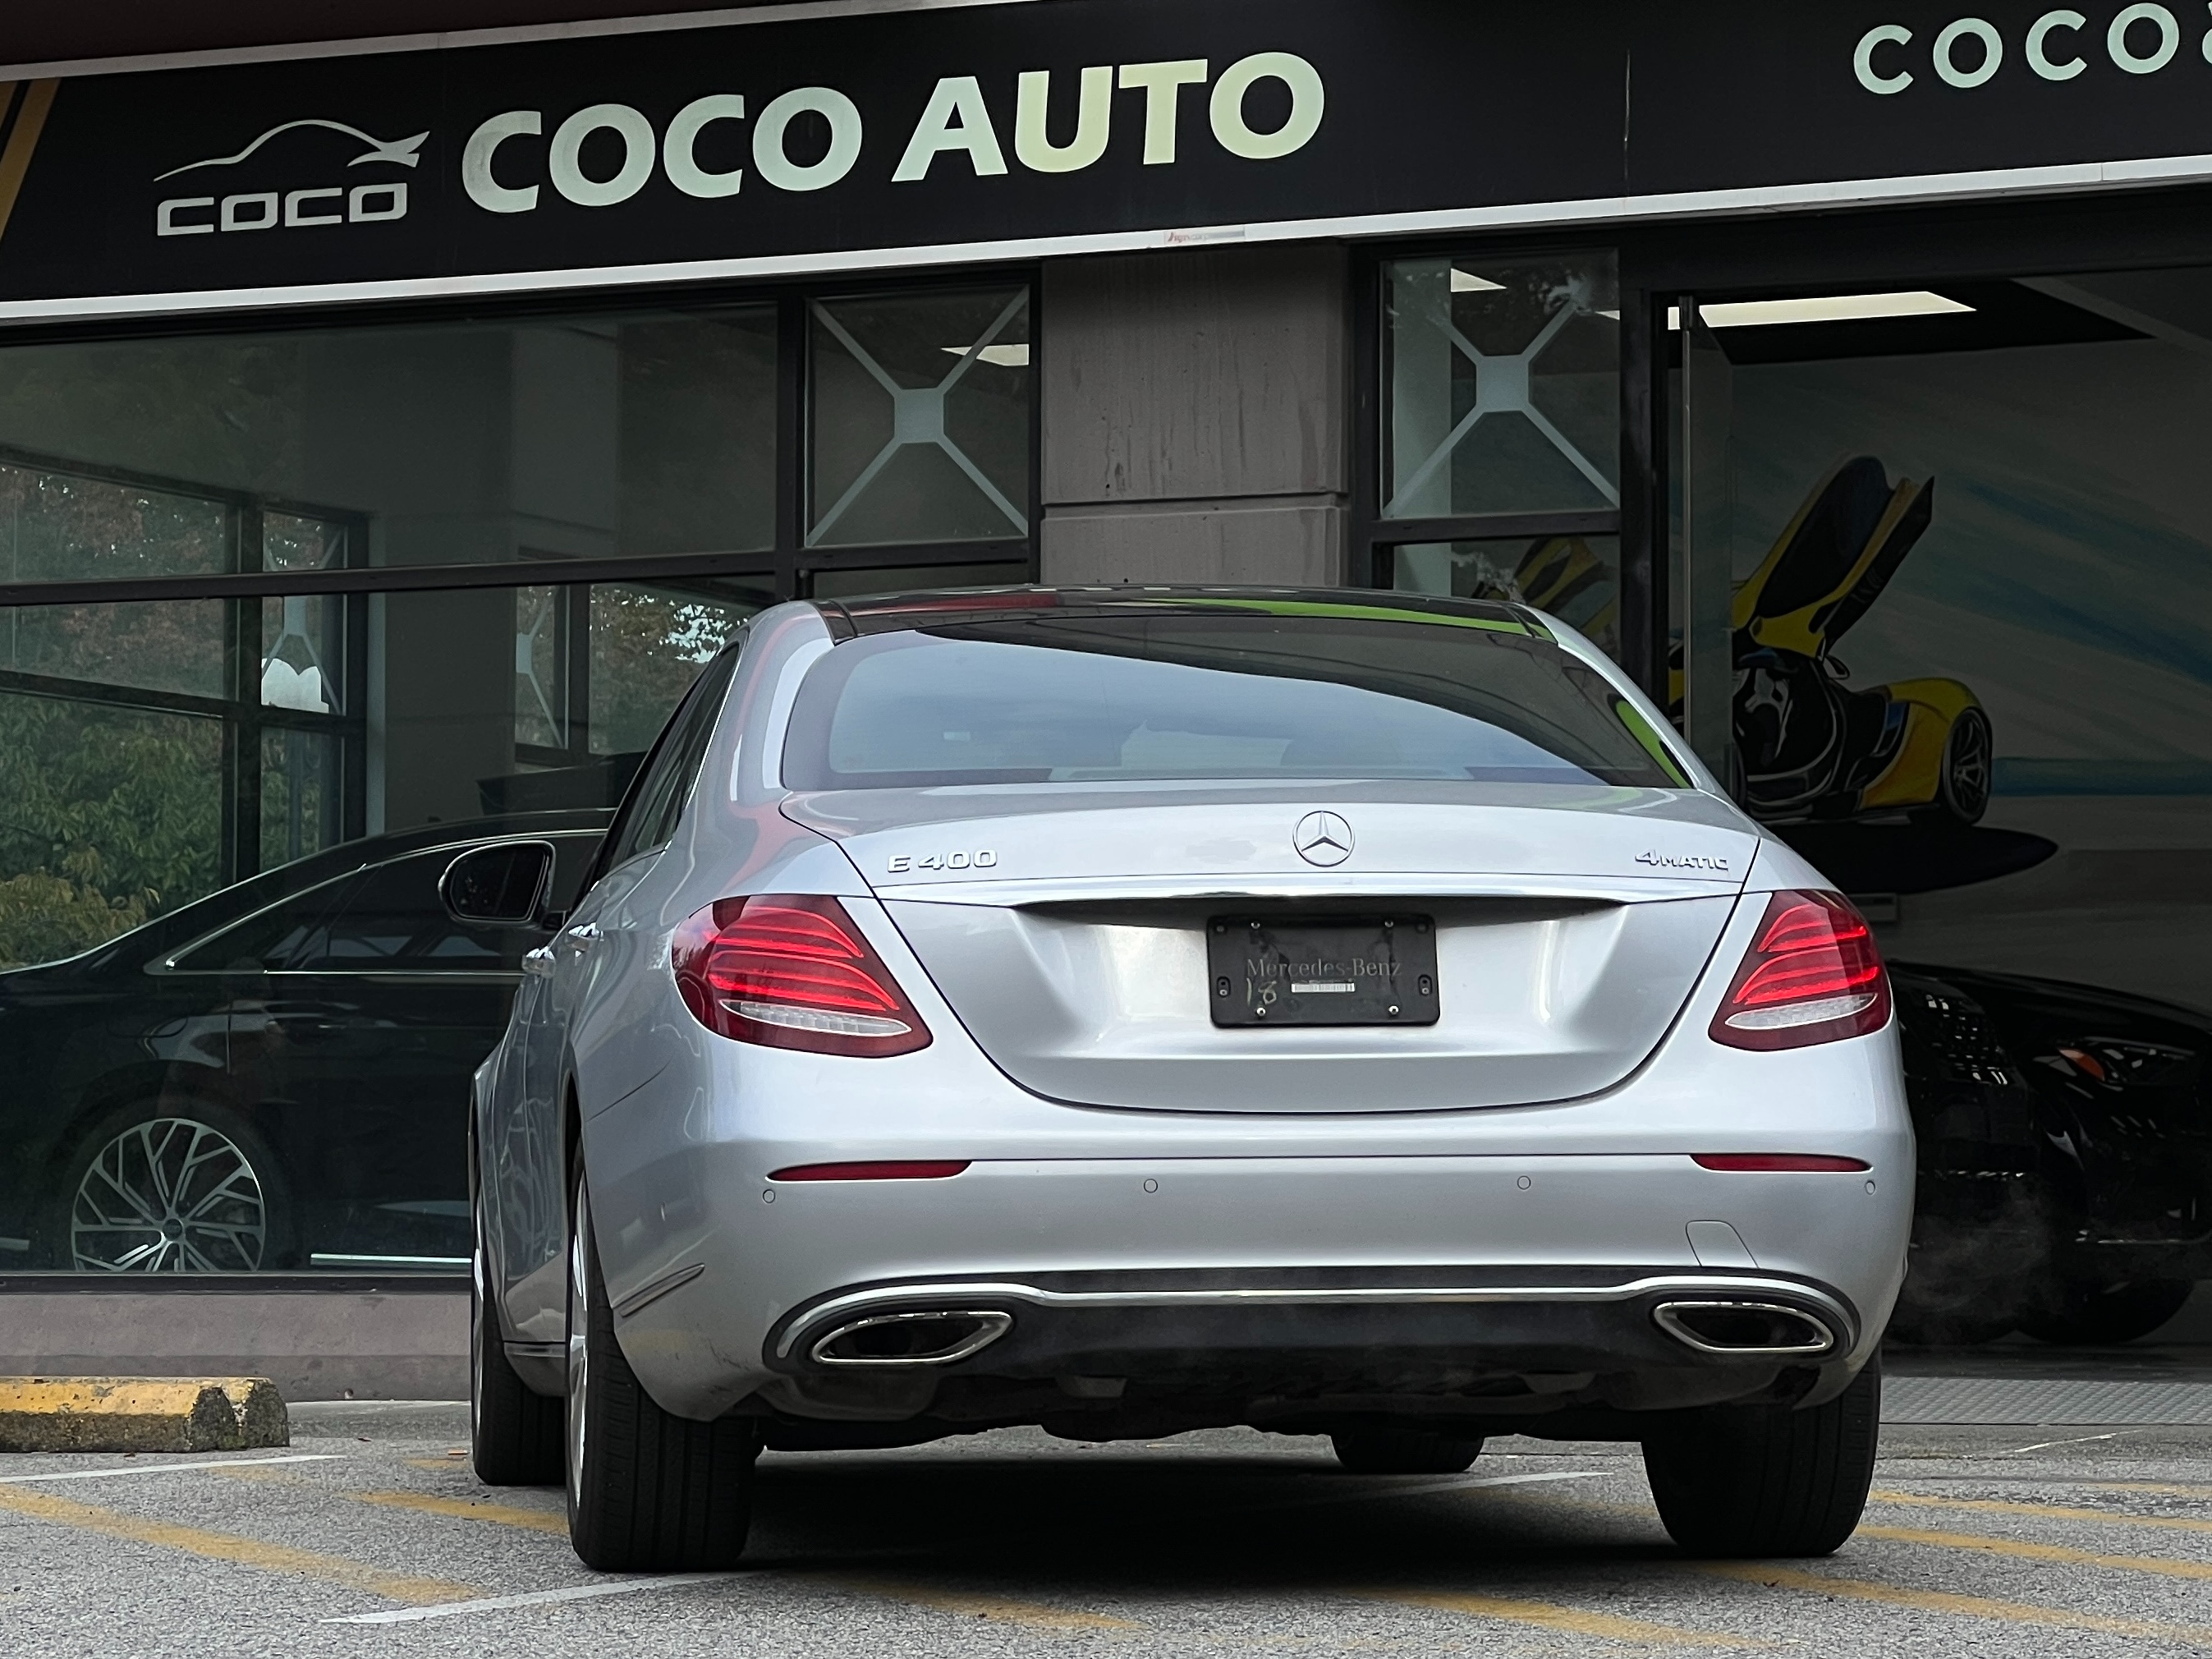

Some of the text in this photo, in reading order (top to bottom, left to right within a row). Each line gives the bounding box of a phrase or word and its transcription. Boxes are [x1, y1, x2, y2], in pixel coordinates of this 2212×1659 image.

[461, 51, 1325, 214] COCO AUTO
[157, 182, 407, 237] COCO
[887, 848, 998, 873] E 400
[1634, 848, 1729, 871] 4MATIC
[1246, 958, 1402, 977] Mercedes-Benz
